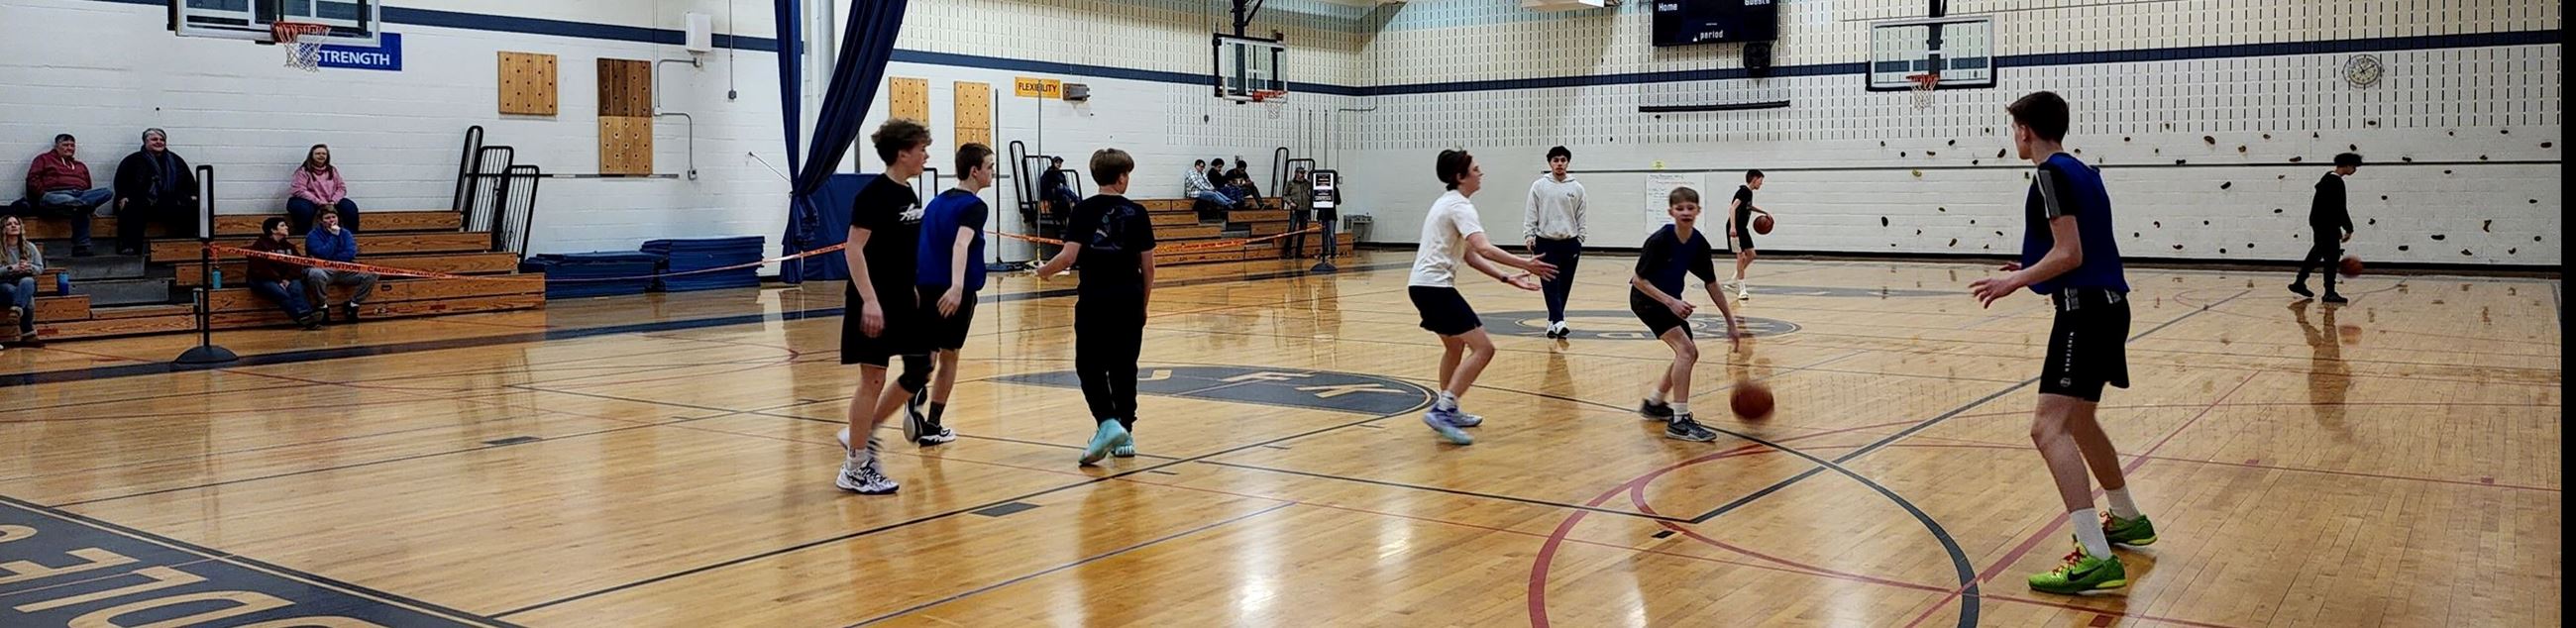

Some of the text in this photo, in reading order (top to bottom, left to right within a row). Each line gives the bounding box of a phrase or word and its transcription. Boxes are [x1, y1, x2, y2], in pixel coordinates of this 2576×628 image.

[1659, 3, 1677, 12] Home
[1699, 30, 1724, 41] period
[1019, 82, 1057, 93] FLEXIBLITY
[277, 255, 316, 265] CAUTION
[322, 261, 361, 270] CAUTION
